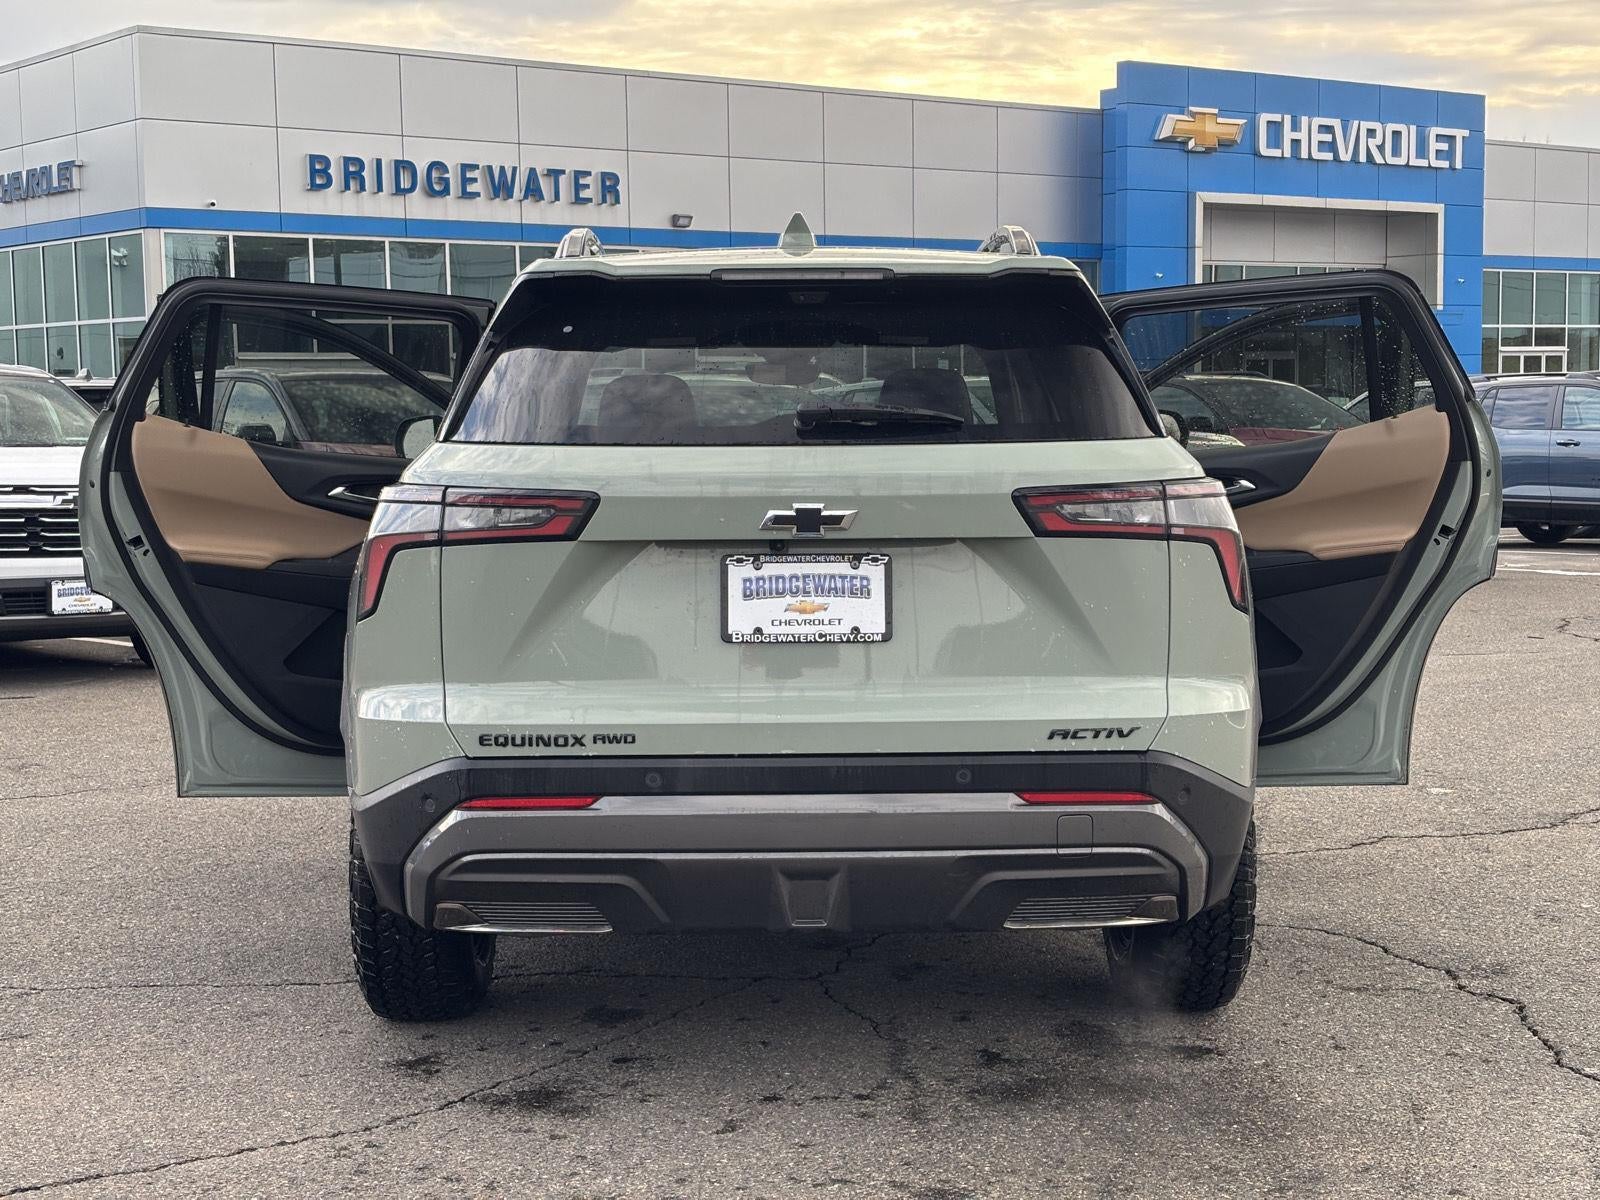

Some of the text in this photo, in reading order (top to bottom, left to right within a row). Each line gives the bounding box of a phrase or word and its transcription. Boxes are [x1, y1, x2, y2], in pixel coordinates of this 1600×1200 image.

[1258, 112, 1470, 170] CHEVROLET
[0, 159, 82, 204] HEVROLET
[306, 153, 622, 206] BRIDGEWATER
[759, 554, 853, 563] BRIDGEWATERCHEVROLET
[57, 586, 94, 598] BRIDGEW
[742, 572, 872, 601] BRIDGEWATER
[771, 618, 843, 627] CHEVROLET
[732, 630, 882, 643] BRIDGEWATERCHEVY.COM
[1047, 726, 1142, 740] ACTIV
[478, 733, 636, 748] EQUINOX AWD
